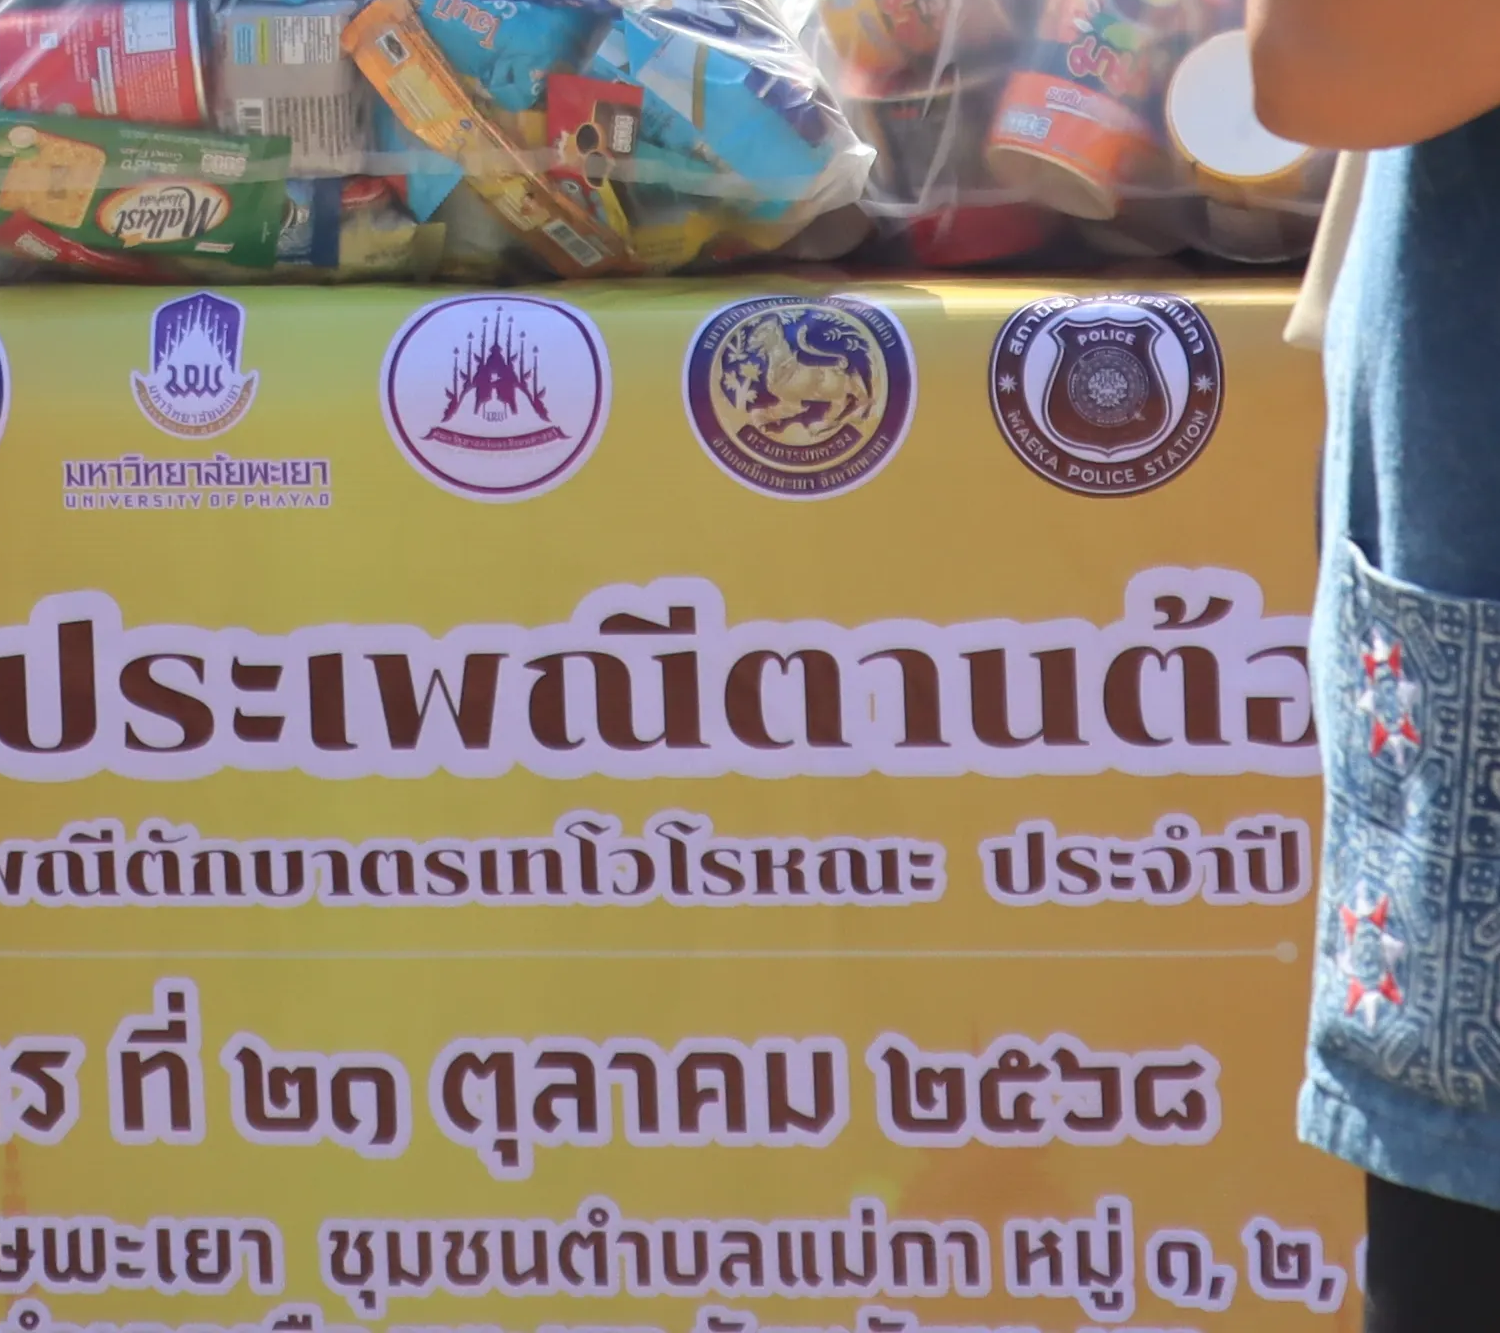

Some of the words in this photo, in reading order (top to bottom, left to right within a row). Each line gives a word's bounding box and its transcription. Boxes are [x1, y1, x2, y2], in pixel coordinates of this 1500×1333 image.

[111, 185, 222, 242] Malkist
[1077, 328, 1137, 347] POLICE
[65, 454, 329, 487] มหาวิทยาลัยพะเยา
[1007, 408, 1059, 471] MAEKA
[1067, 463, 1137, 486] POLICE
[1143, 409, 1209, 478] STATION
[64, 492, 201, 509] UNIVERSITY
[209, 492, 238, 508] OF
[244, 491, 331, 508] PHAYAO
[991, 823, 1301, 896] ประจำปี
[119, 990, 192, 1132] ที่
[234, 1045, 398, 1146] ๒๑
[441, 1046, 836, 1168] ตุลาคม
[880, 1044, 1208, 1133] ๒๕๖๘
[328, 1205, 980, 1309] ชุมชนตำบลแม่กา
[1014, 1205, 1124, 1312] หมู่
[1253, 1226, 1336, 1301] ๒,
